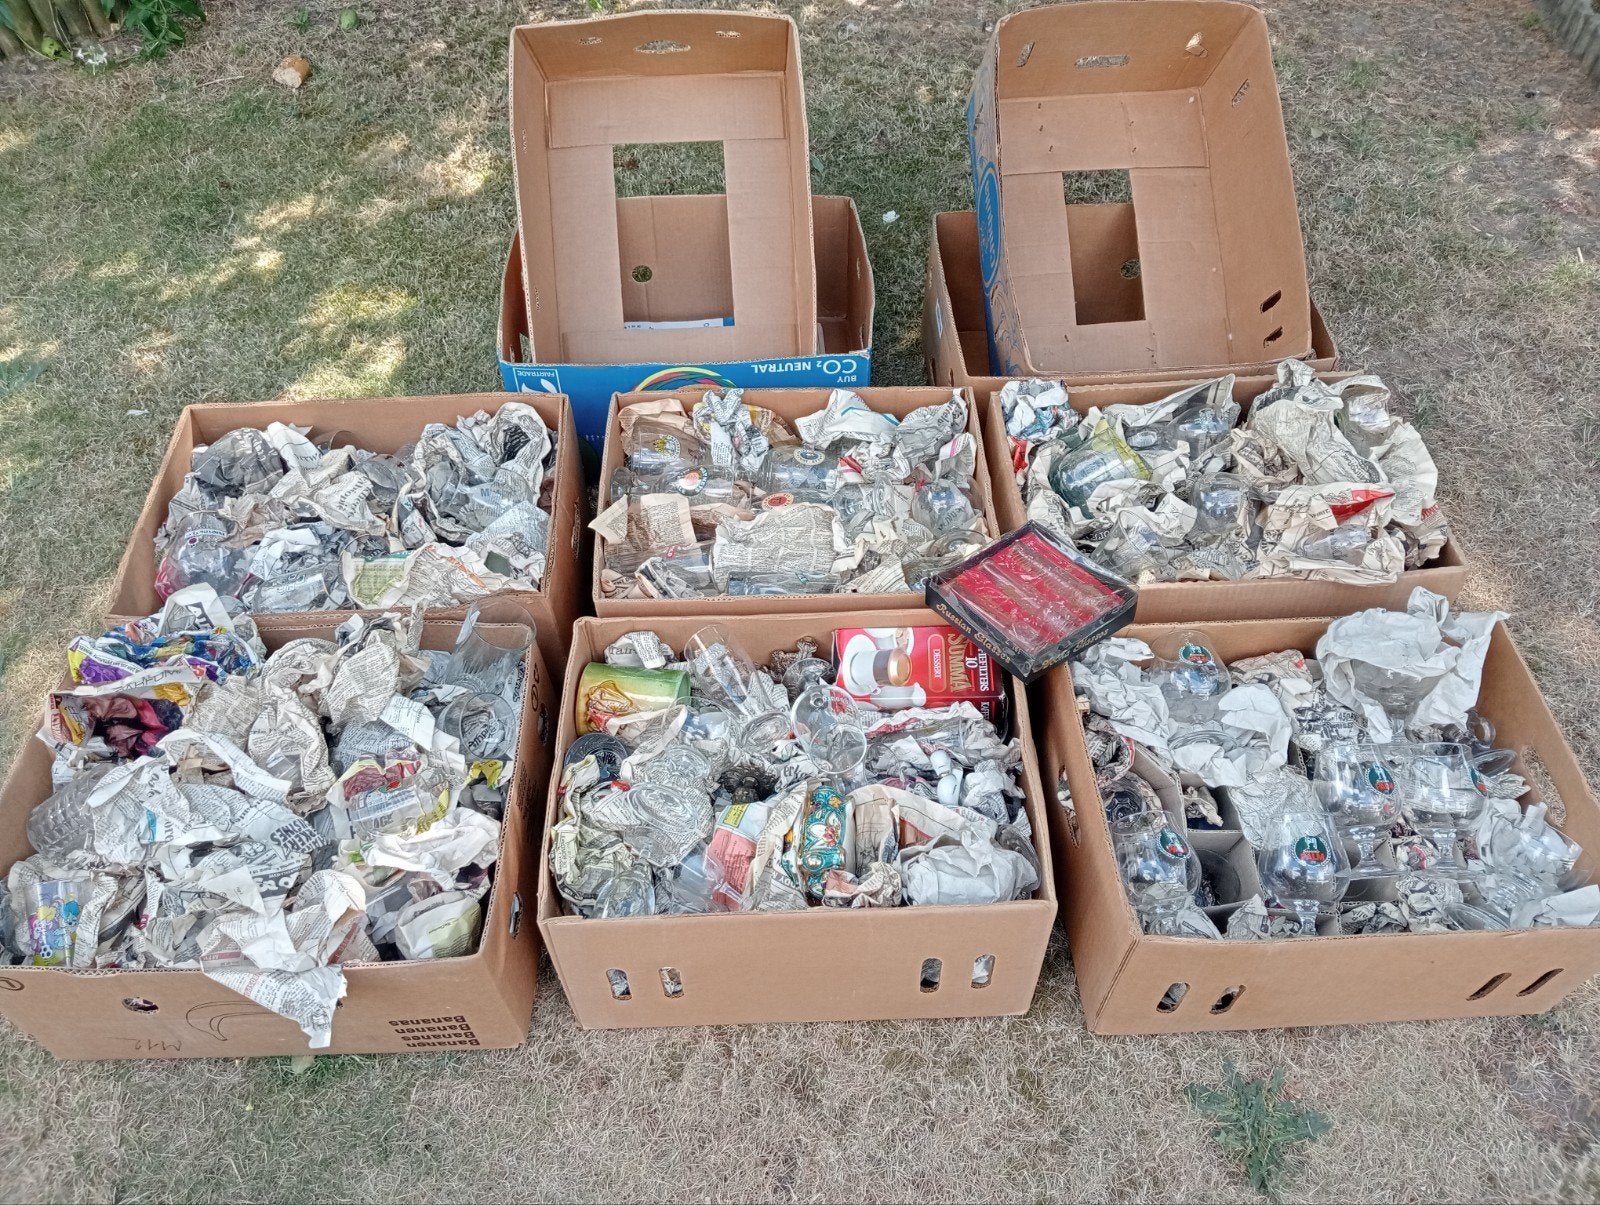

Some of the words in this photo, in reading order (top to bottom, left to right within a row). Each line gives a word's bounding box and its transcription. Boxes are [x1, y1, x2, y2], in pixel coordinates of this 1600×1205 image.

[751, 361, 812, 374] NEUTRAL
[516, 369, 557, 378] FAIRTRADE
[836, 375, 857, 384] BUY
[936, 603, 972, 634] Russian
[974, 629, 1011, 665] Glasses
[933, 649, 942, 679] DESSERT
[947, 632, 972, 693] SUMMA
[965, 656, 978, 669] 10
[388, 1015, 467, 1026] Bananas
[394, 1023, 471, 1034] Bananen
[401, 1031, 476, 1041] Bananes
[406, 1039, 480, 1048] Bananen
